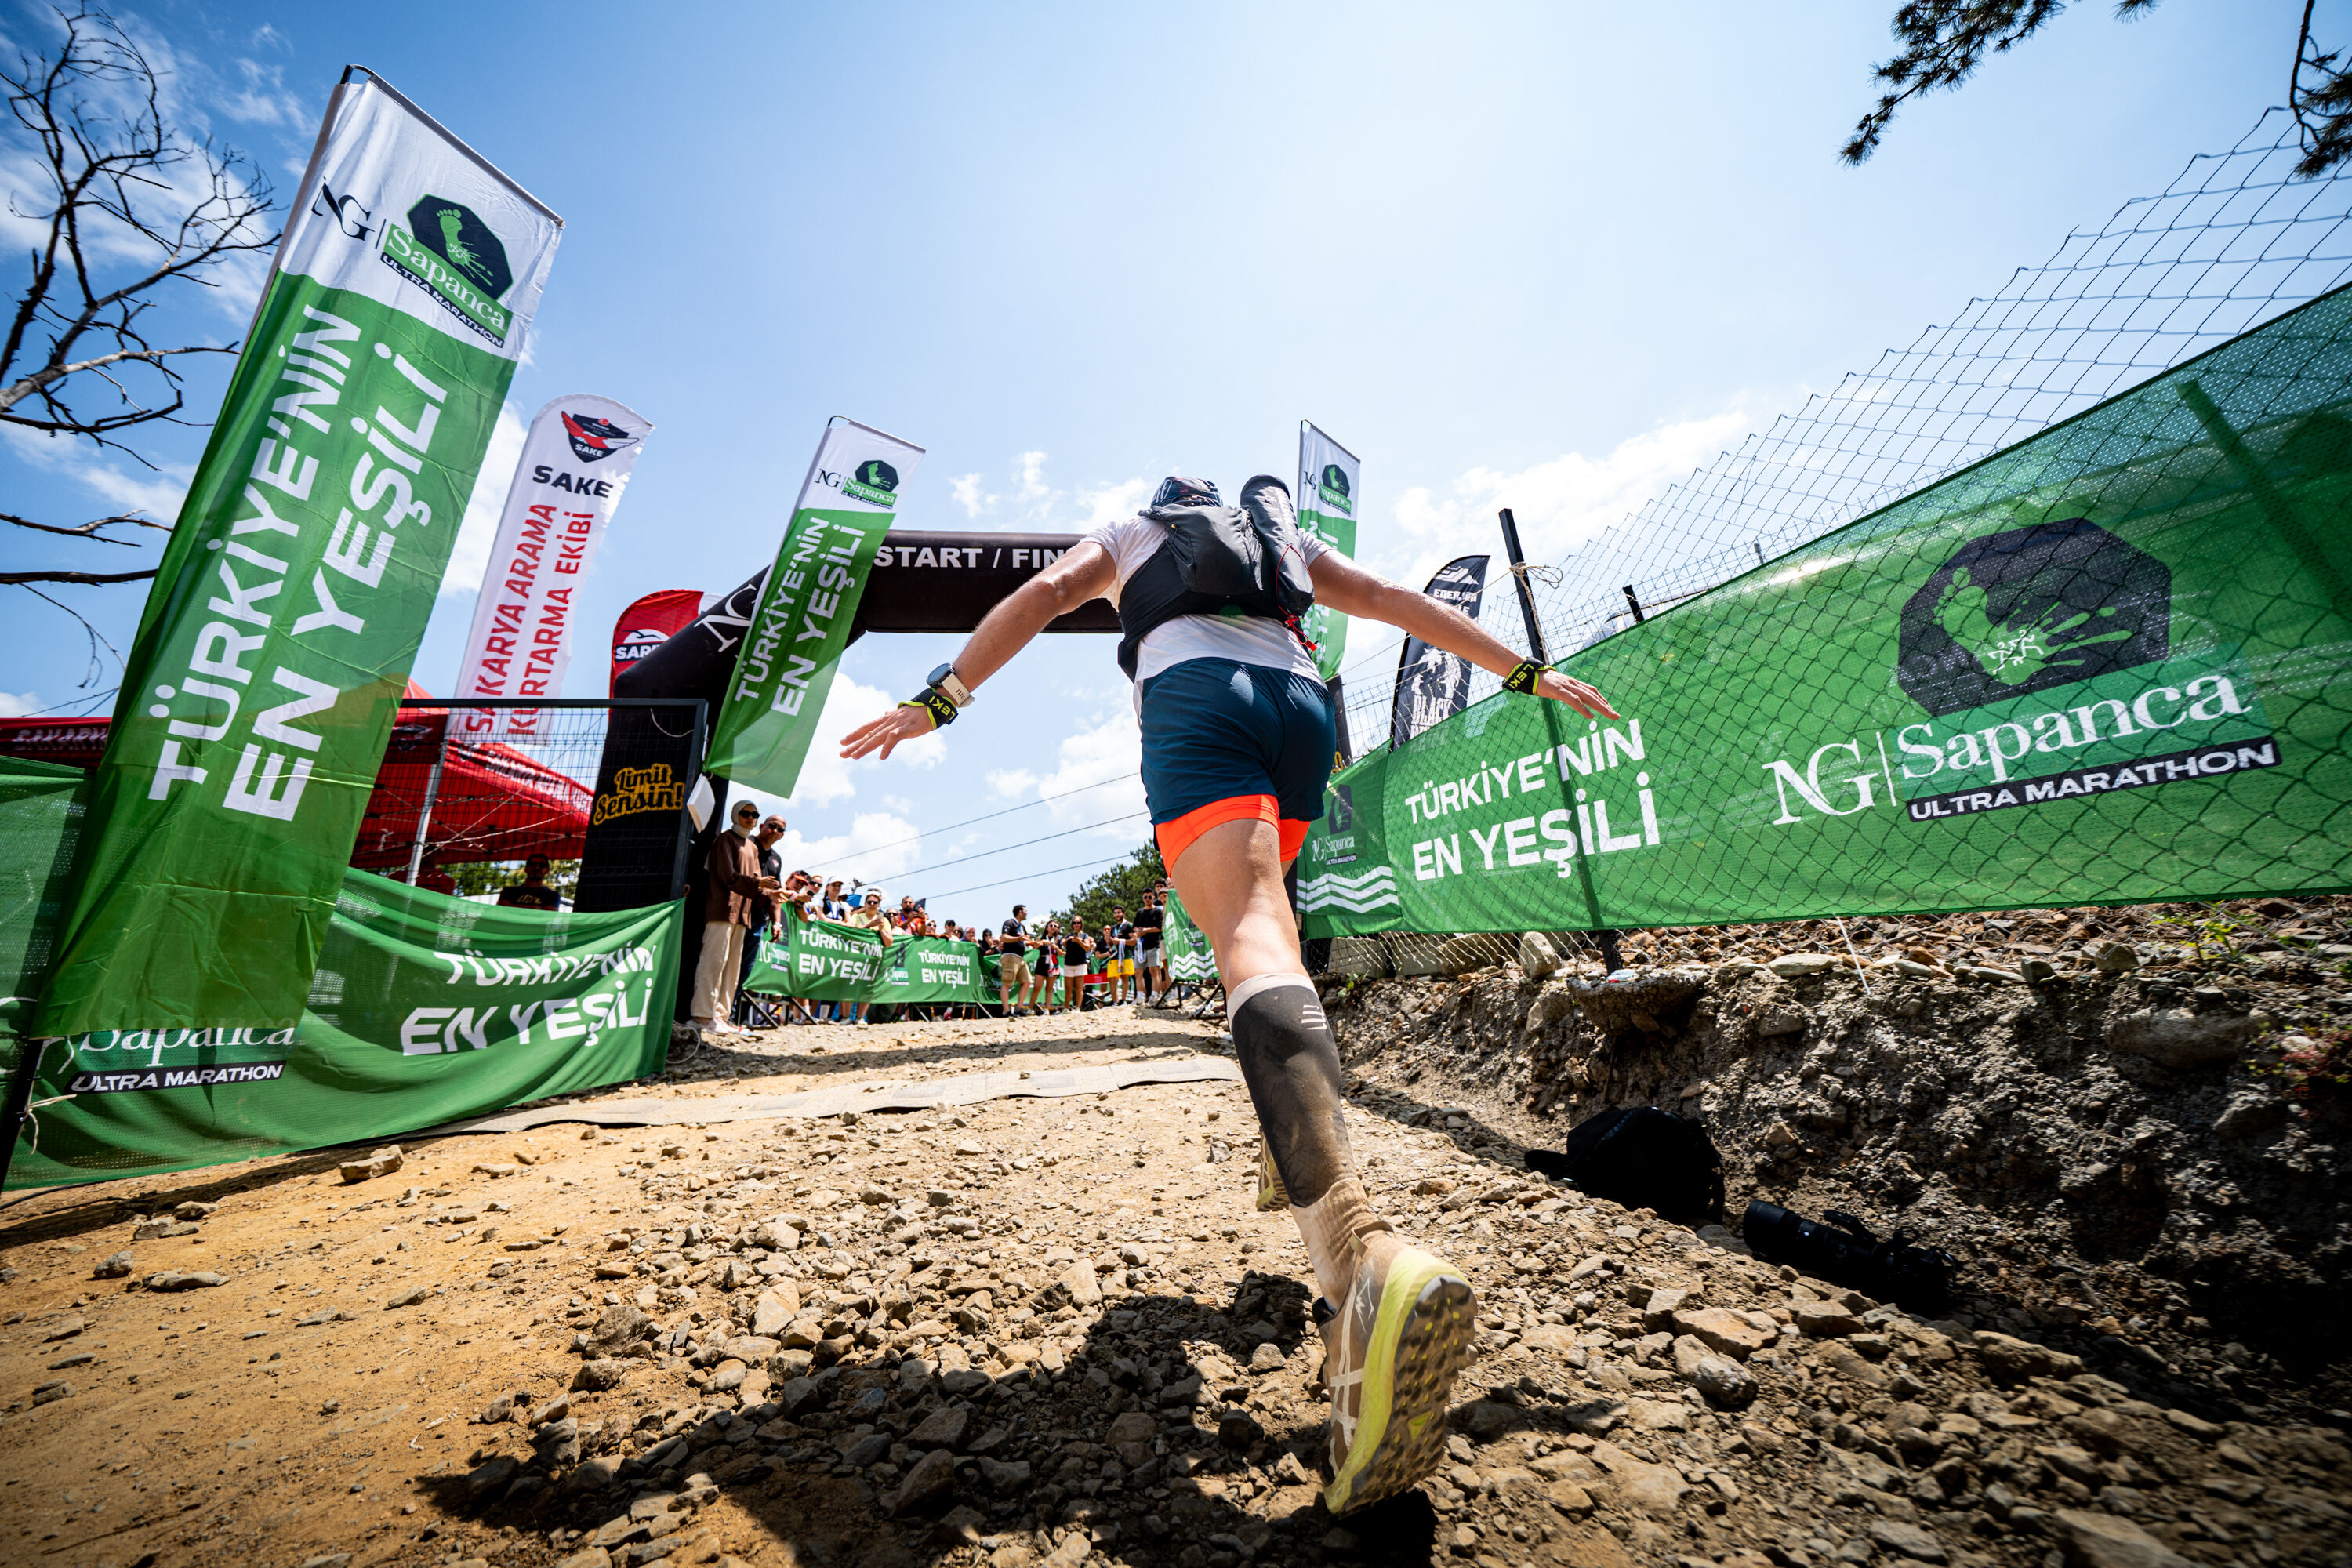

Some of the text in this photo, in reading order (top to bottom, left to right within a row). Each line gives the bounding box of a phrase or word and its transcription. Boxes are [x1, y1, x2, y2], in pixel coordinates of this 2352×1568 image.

[382, 254, 503, 347] ULTRA MARATHON
[388, 228, 506, 331] Sapanca
[532, 465, 614, 499] SAKE
[574, 444, 604, 457] SAKE
[845, 478, 895, 503] Sapanca
[147, 303, 361, 801] TÜRKİYE'NİN
[505, 504, 557, 600] ARAMA
[554, 511, 594, 574] EKİBİ
[873, 546, 983, 568] START
[993, 548, 1002, 568] /
[222, 343, 448, 822] EN YEŞİLİ
[735, 517, 830, 702] TÜRKİYE'NİN
[771, 524, 866, 716] EN YEŞİLİ
[929, 695, 956, 720] LEKI
[1508, 664, 1534, 689] LEKI
[1897, 673, 2254, 784] Sapanca
[614, 763, 673, 793] Limit
[1405, 718, 1646, 824] TÜRKİYE'NİN
[1762, 742, 1878, 826] NG
[1911, 743, 2275, 820] ULTRA MARATHON
[593, 782, 685, 826] Sensin!
[1412, 771, 1661, 882] EN YEŞİLİ
[1325, 836, 1355, 857] Sapanca
[433, 941, 657, 987] TÜRKİYENİN
[799, 953, 823, 975] EN
[829, 957, 881, 985] YEŞİLİ
[921, 968, 937, 984] EN
[938, 967, 970, 989] YEŞİLİ
[400, 978, 653, 1057] EN YEŞİLİ
[71, 1065, 285, 1092] ULTRA MARATHON
